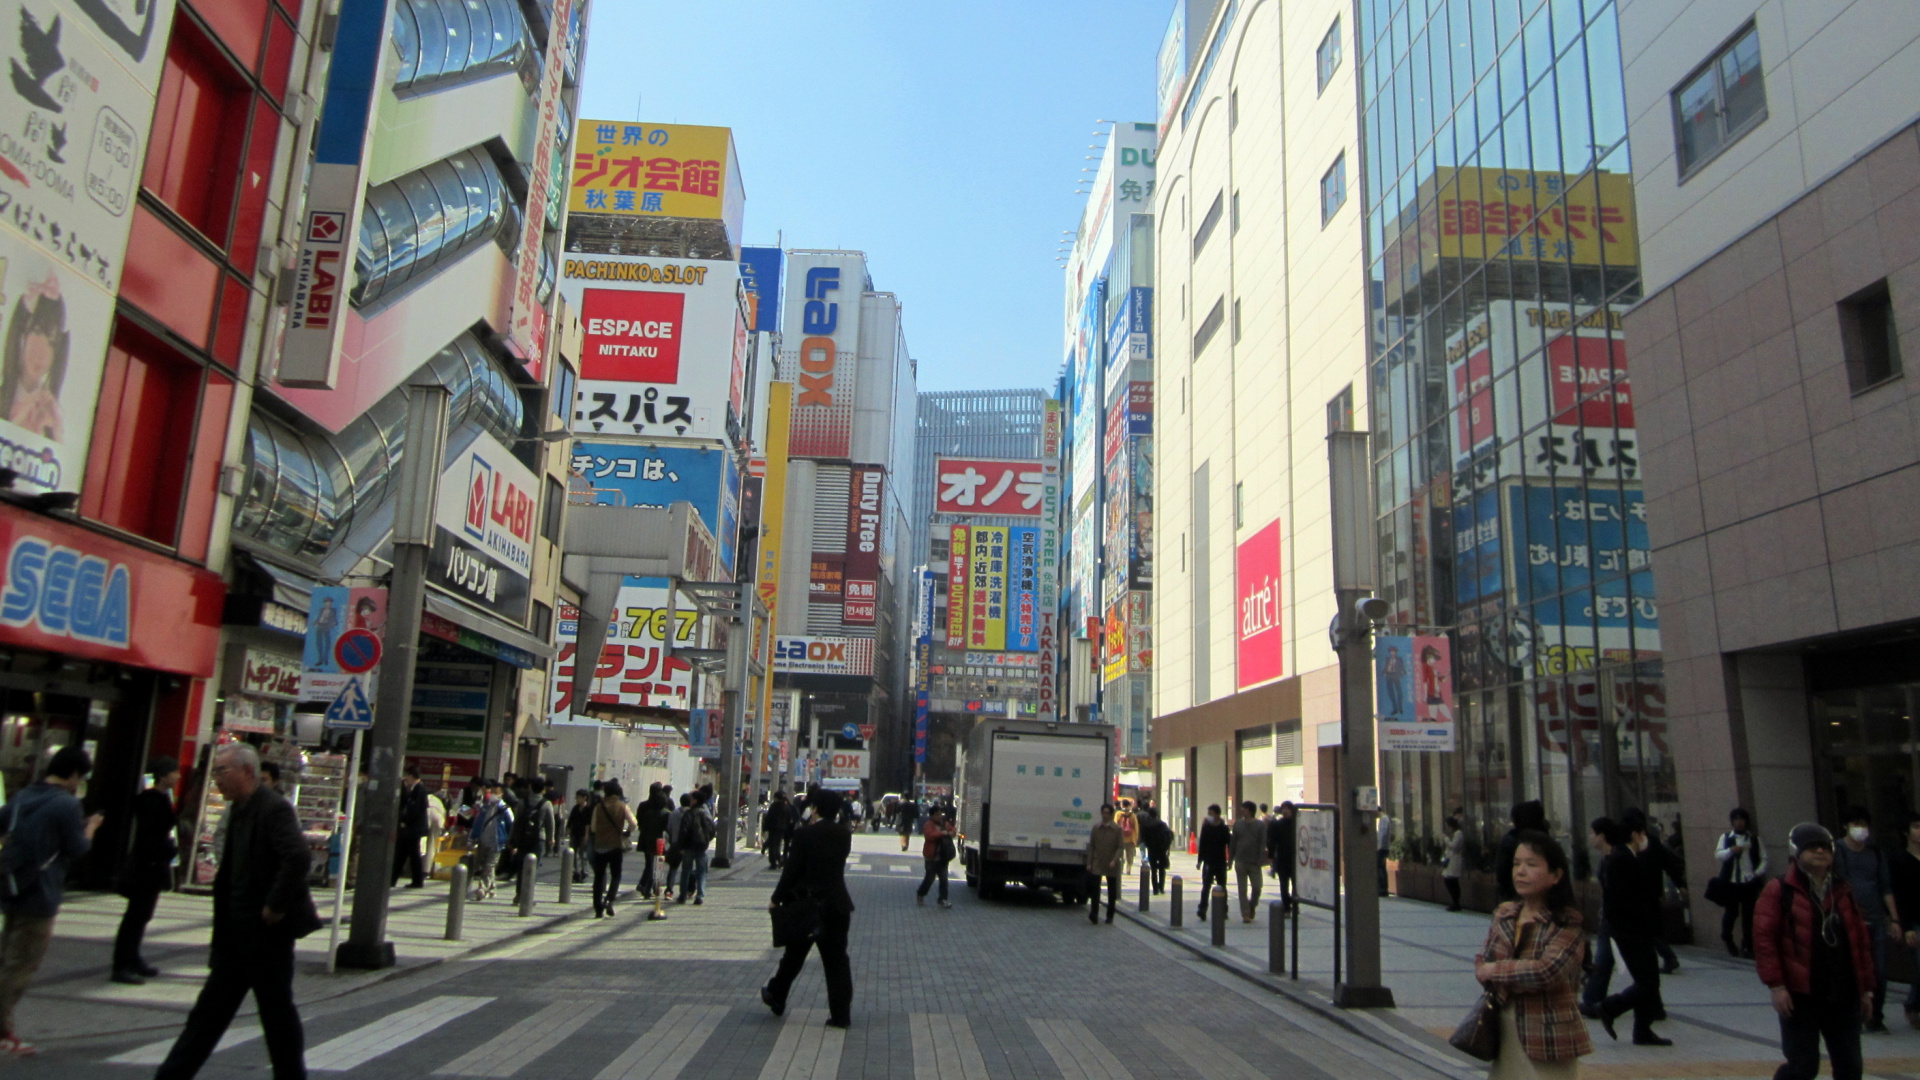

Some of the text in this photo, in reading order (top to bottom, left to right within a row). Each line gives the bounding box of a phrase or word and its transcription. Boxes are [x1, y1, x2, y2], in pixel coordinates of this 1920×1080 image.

[596, 124, 669, 147] 世界の
[585, 188, 664, 212] 秋葉原
[291, 249, 340, 330] LABI AKIHABARA
[588, 318, 673, 339] ESPACE
[599, 344, 658, 358] NITTAKU
[570, 456, 679, 483] チンコは、
[491, 471, 536, 545] LABI
[859, 471, 881, 553] Duty Free
[1043, 485, 1056, 567] DUTY FREE
[487, 529, 530, 570] AKIHABARA
[1, 540, 129, 645] SEGA
[848, 584, 873, 596] 免税
[920, 578, 932, 637] Panasonic
[949, 584, 965, 637] DUTYFREE
[1242, 574, 1272, 636] atré
[626, 607, 698, 641] 767
[788, 661, 825, 669] Electronics
[919, 643, 930, 692] ONODEN
[1040, 612, 1053, 714] TAKARADA
